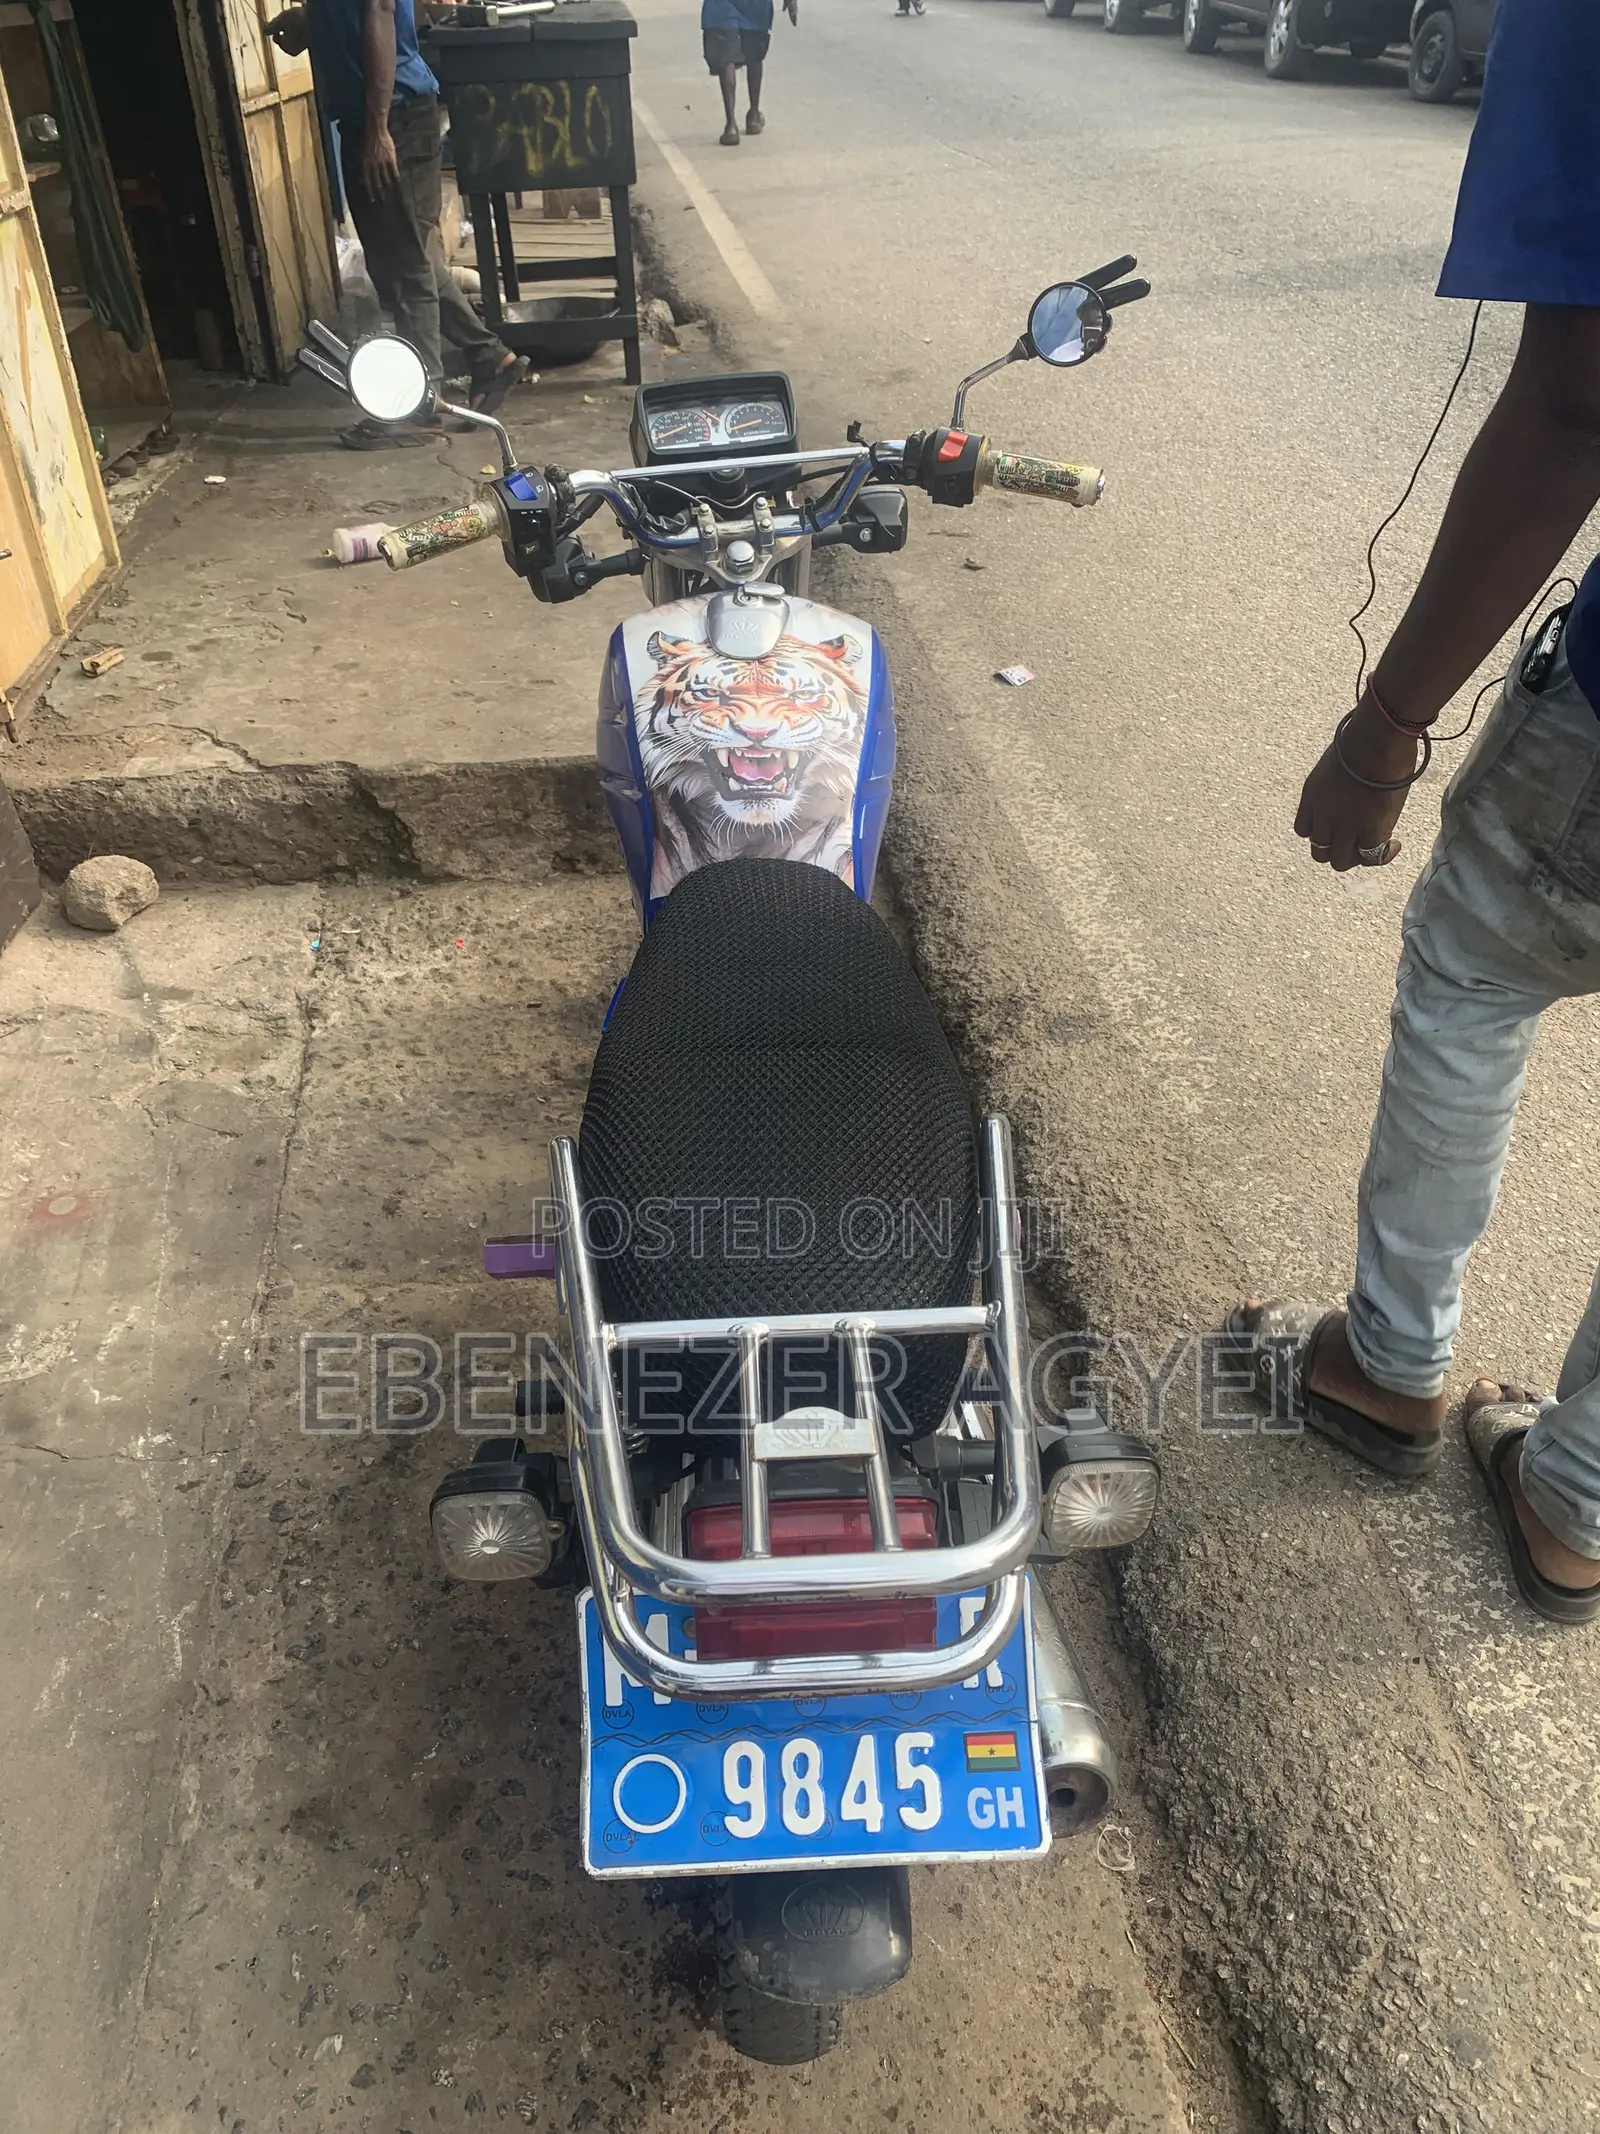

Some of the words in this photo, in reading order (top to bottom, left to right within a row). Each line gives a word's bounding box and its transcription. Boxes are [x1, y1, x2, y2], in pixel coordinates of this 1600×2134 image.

[605, 1710, 632, 1719] DVLA
[699, 1703, 726, 1713] DVLA
[723, 1731, 942, 1839] 9845
[967, 1786, 1025, 1829] GH
